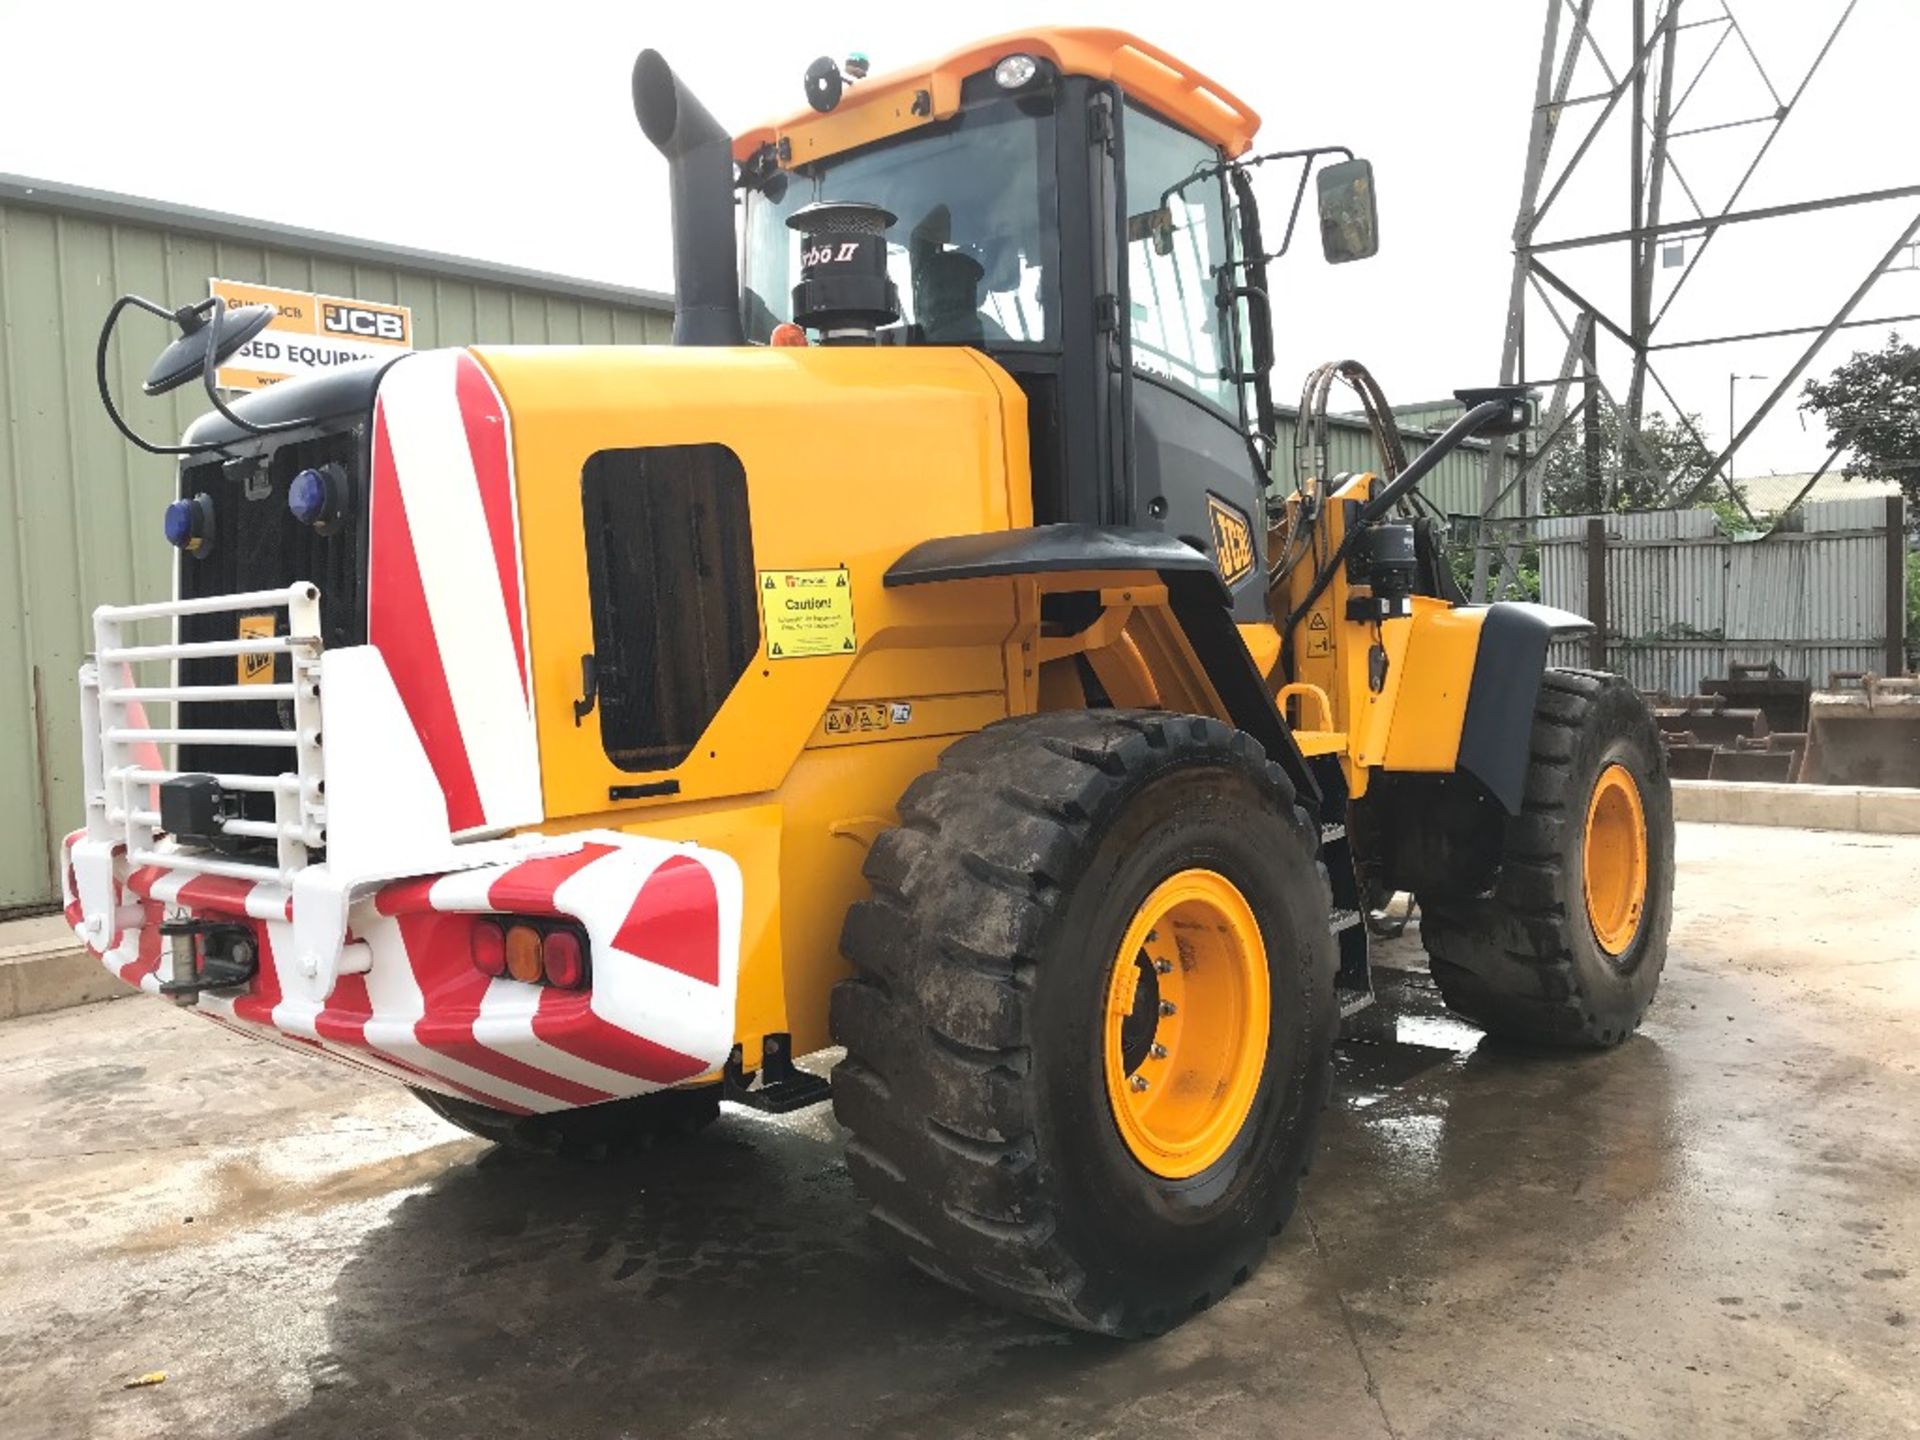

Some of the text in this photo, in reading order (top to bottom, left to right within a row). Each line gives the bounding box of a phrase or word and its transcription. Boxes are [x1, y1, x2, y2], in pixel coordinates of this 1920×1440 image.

[803, 243, 859, 267] rbo II
[277, 305, 303, 318] JCB
[326, 308, 403, 339] JCB
[240, 341, 374, 367] SED EQUIPM
[1216, 511, 1252, 576] JCB
[785, 597, 832, 611] Caution!
